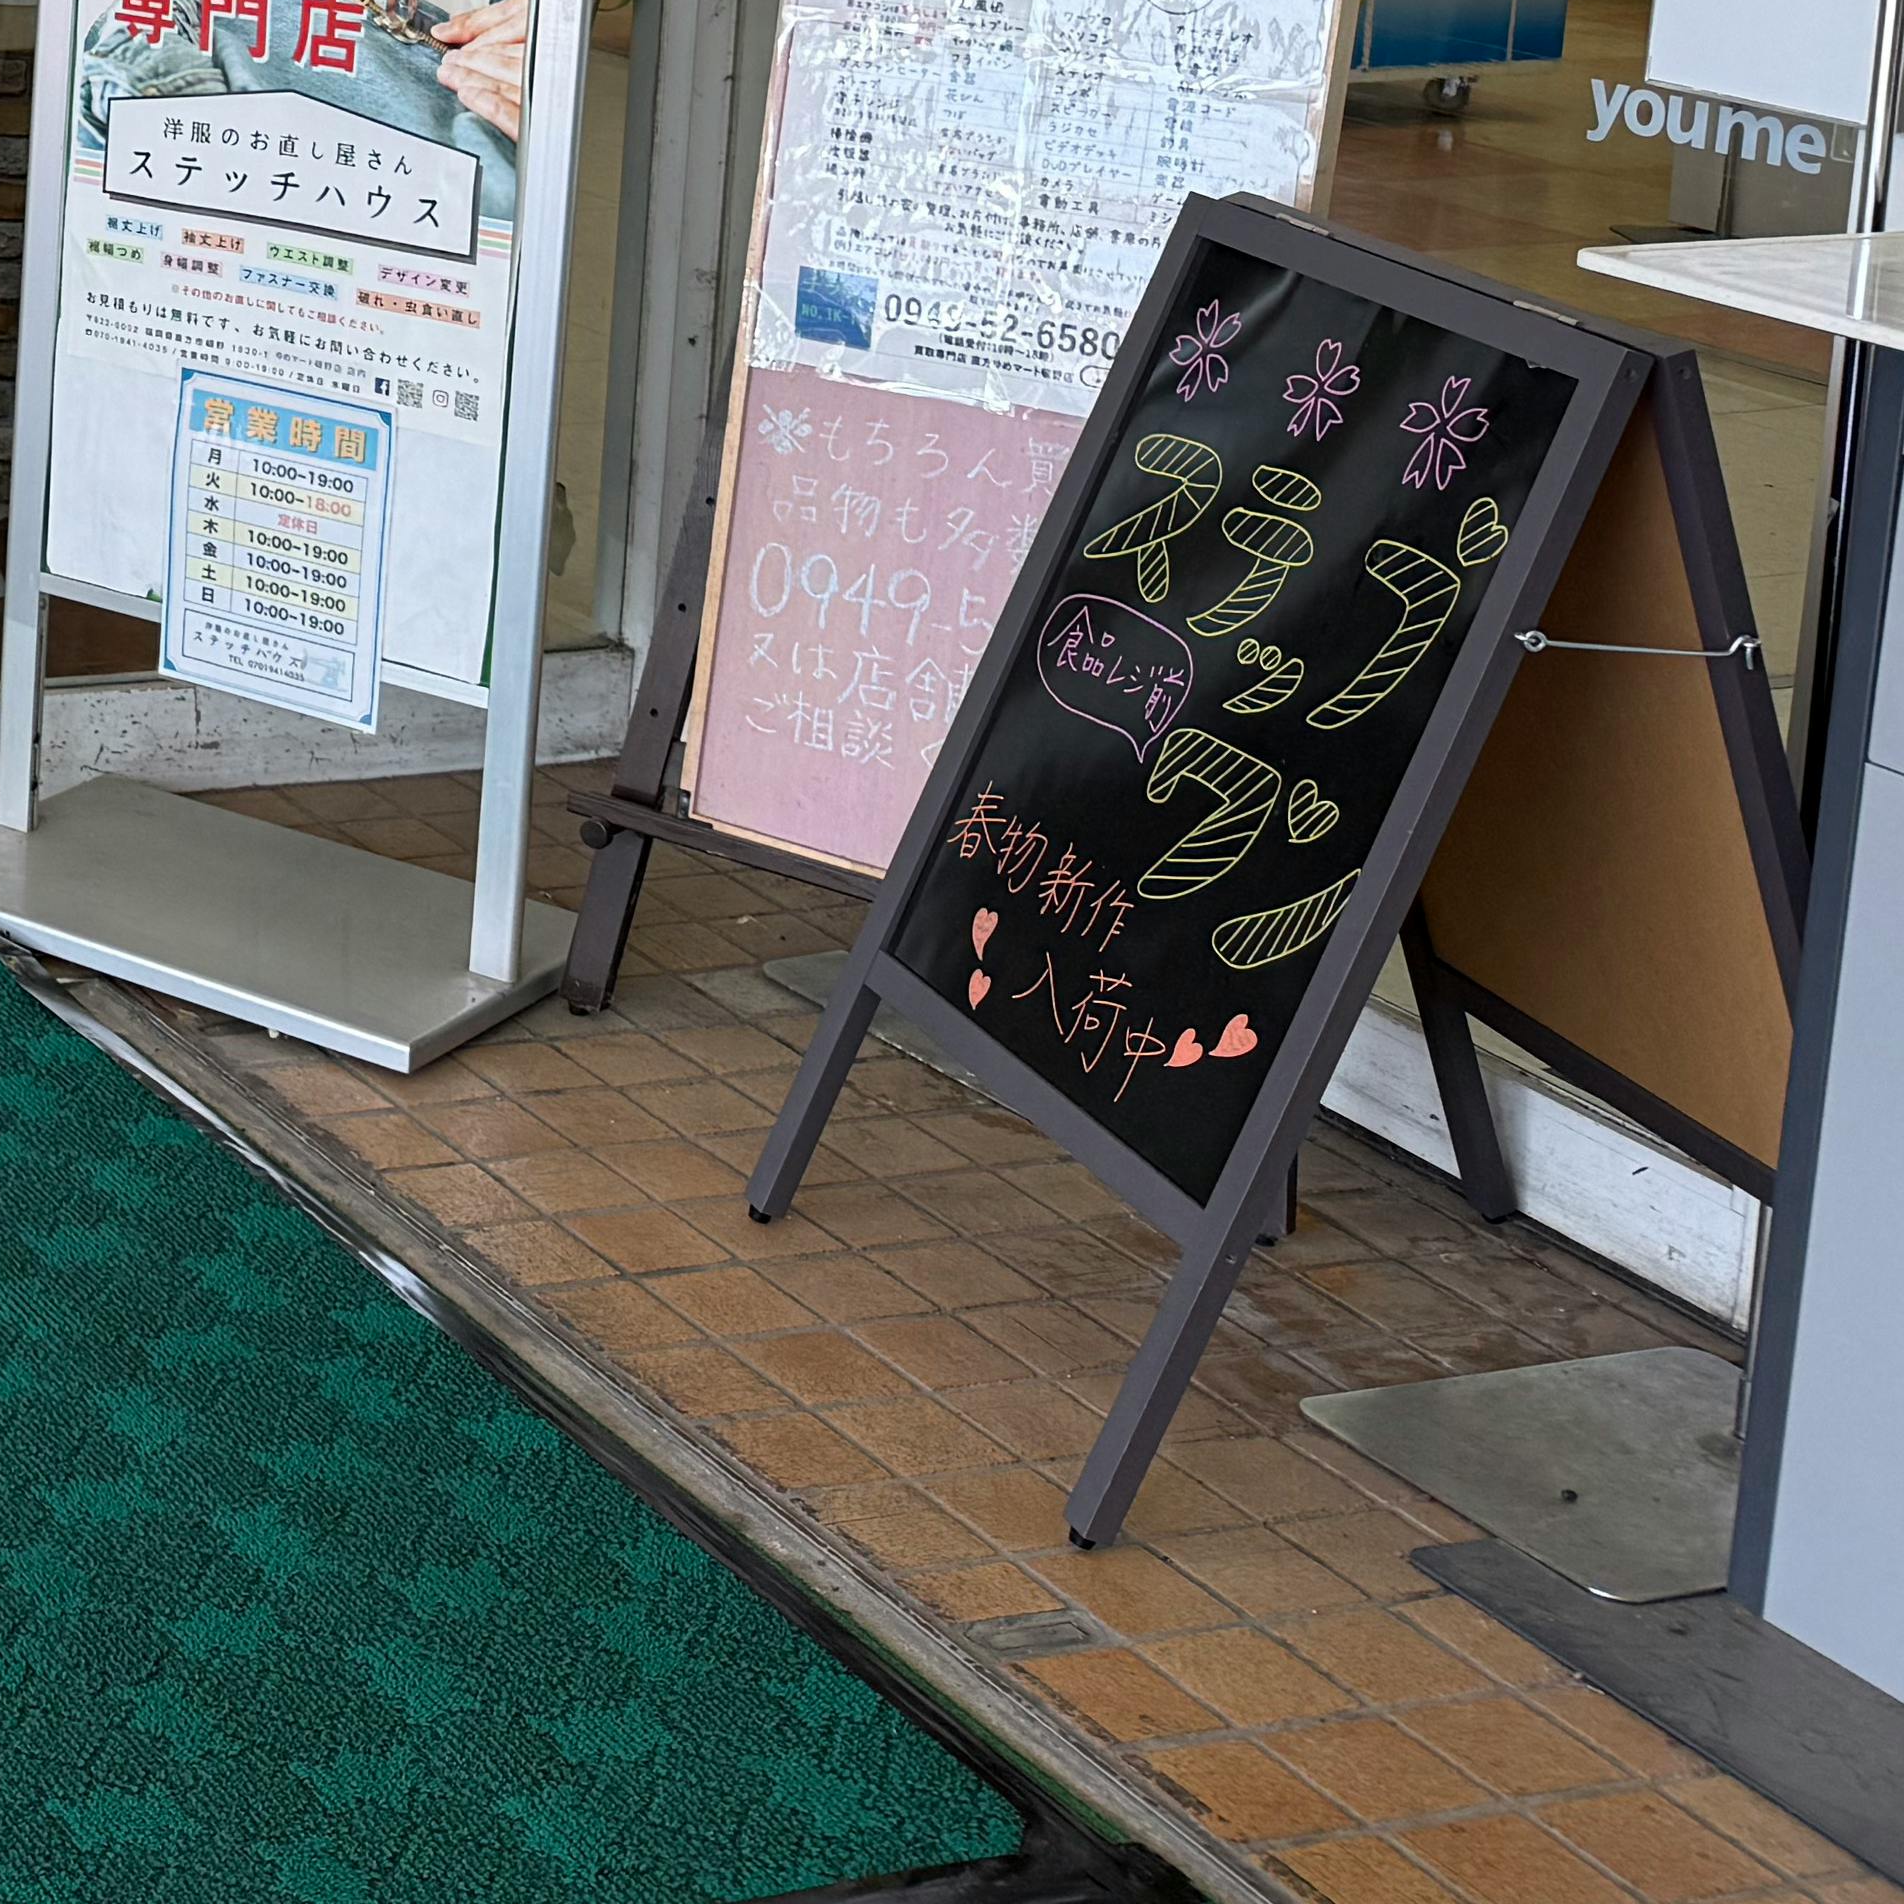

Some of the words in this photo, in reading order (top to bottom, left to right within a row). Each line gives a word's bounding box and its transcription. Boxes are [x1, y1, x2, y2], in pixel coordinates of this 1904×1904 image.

[163, 118, 413, 176] 洋服のお直し屋さん
[1587, 78, 1826, 174] youme
[129, 149, 440, 228] ステッチハウス
[163, 254, 220, 275] 身幅調整
[242, 268, 336, 297] ファスナー交換
[269, 246, 350, 273] ウエスト調整
[380, 268, 468, 296] デザイン変更
[204, 398, 366, 464] 営業時間
[208, 448, 222, 465] 月
[206, 472, 221, 489] 火
[204, 496, 220, 511] 水
[203, 518, 219, 534] 木
[202, 542, 218, 558] 金
[202, 565, 217, 581] 土
[202, 587, 214, 604] 日
[229, 654, 244, 667] TEL
[1050, 606, 1188, 732] 食品レジ前
[946, 780, 1136, 953] 春物新作
[1010, 951, 1168, 1104] 入荷中
